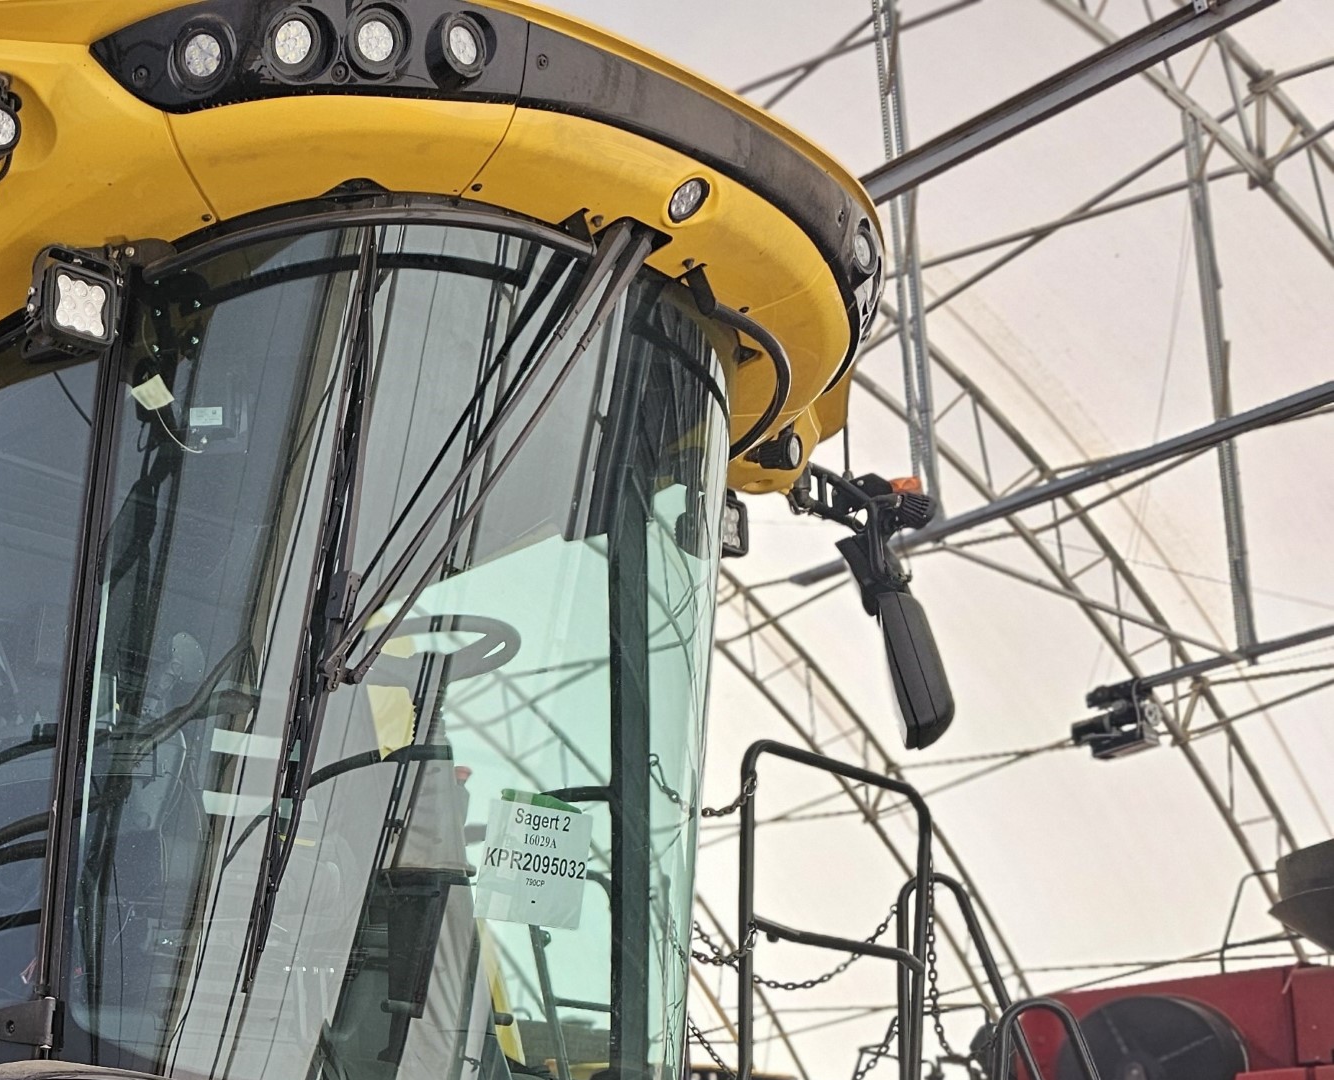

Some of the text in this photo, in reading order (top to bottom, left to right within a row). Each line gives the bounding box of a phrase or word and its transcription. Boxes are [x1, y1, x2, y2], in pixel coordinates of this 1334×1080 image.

[515, 807, 571, 832] Sagert 2
[524, 833, 557, 849] 16029A
[484, 847, 586, 880] KPR2095032
